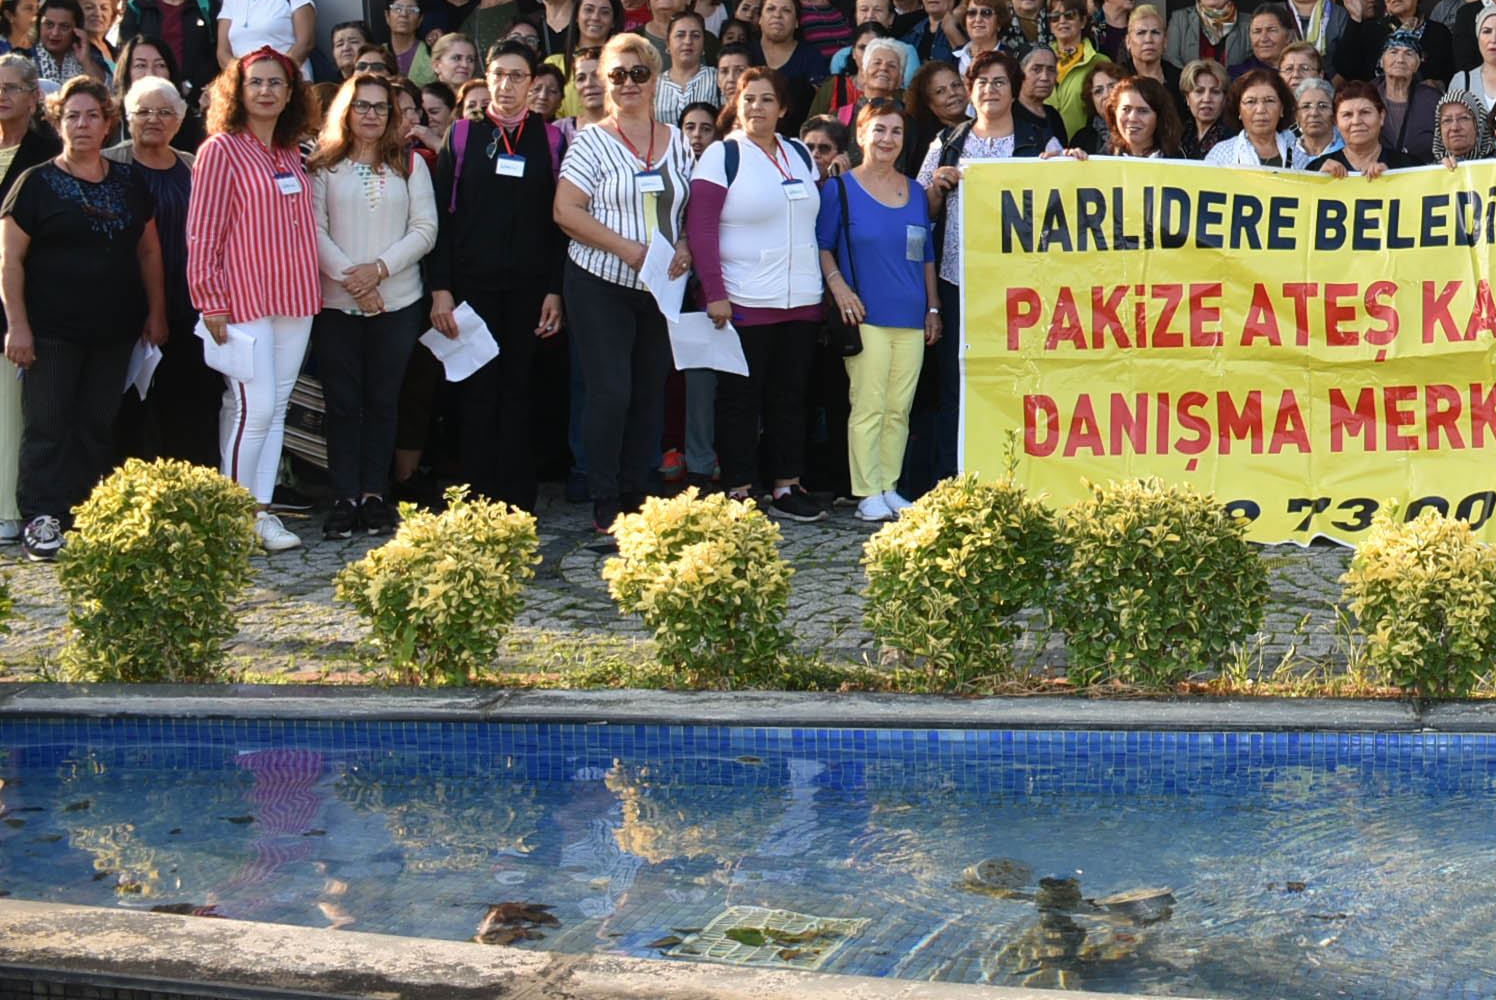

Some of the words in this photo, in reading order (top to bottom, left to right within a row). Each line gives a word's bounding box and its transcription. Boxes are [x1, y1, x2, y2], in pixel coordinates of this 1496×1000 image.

[1000, 186, 1298, 254] NARLIDERE
[1239, 280, 1400, 363] ATEŞ
[1022, 389, 1313, 471] DANIŞMA
[1286, 497, 1380, 532] 73
